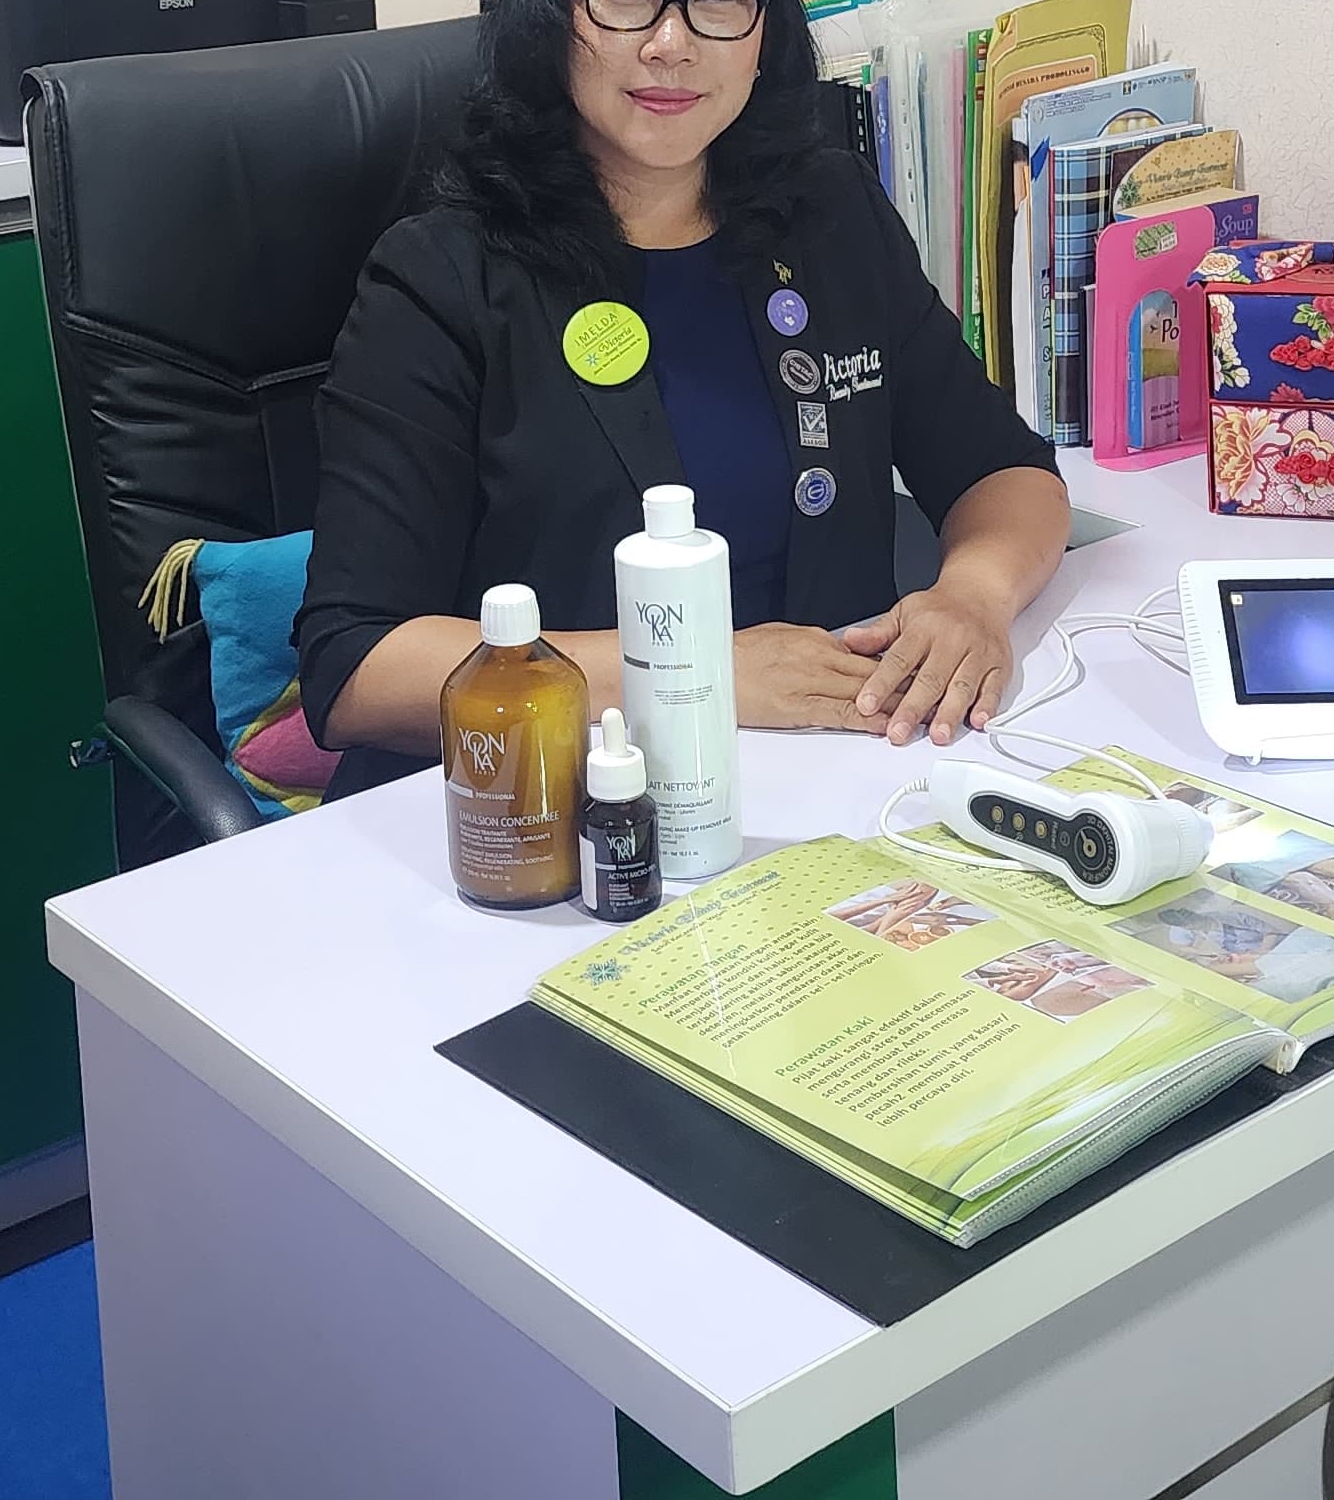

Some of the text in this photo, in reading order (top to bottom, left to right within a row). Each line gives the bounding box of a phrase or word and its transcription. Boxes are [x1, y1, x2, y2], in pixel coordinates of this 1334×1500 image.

[1219, 214, 1255, 238] Soup
[574, 312, 618, 347] IMELDA
[823, 346, 882, 385] Victoria
[634, 601, 684, 629] YON
[651, 614, 674, 642] KA
[653, 662, 694, 671] PROFESSIONAL
[458, 727, 506, 758] YON
[472, 741, 496, 772] KA
[475, 791, 516, 800] PROFESSIONAL
[648, 780, 661, 792] AIT
[606, 835, 636, 853] YON
[637, 943, 749, 1009] Perawatan Tangan
[653, 991, 692, 1014] Manfaat
[740, 942, 773, 962] tangan
[772, 927, 801, 945] antara
[798, 917, 819, 929] lain
[676, 999, 715, 1026] menjadi
[746, 970, 765, 983] dan
[764, 956, 794, 973] halus,
[792, 941, 817, 957] serta
[813, 931, 835, 943] bila
[687, 1008, 719, 1031] terjadi
[748, 976, 778, 996] akibat
[776, 960, 806, 978] sabun
[803, 939, 843, 962] ataupun
[723, 961, 759, 983] kondisi
[756, 950, 780, 965] kulit
[778, 938, 799, 954] agar
[741, 989, 776, 1012] melalui
[775, 958, 828, 992] pengurutan
[827, 946, 850, 961] akan
[710, 949, 866, 1042] meningkatkan peredaran darah dan
[721, 951, 884, 1048] getah bening dalam sel sel jaringan.
[774, 1014, 876, 1078] Perawatan Kaki
[791, 990, 947, 1085] Pijat kaki sangat efektif dalam
[806, 987, 977, 1093] mengurangi stres dan kecemasan
[821, 1006, 971, 1099] serta membuat Anda merasa
[847, 1011, 1011, 1113] Pembersihan tumit yang kasar/
[834, 1047, 931, 1107] tenang dan rileks.
[864, 1021, 1022, 1122] pecah2 membuat penampilan
[876, 1068, 975, 1129] lebih percaya diri.
